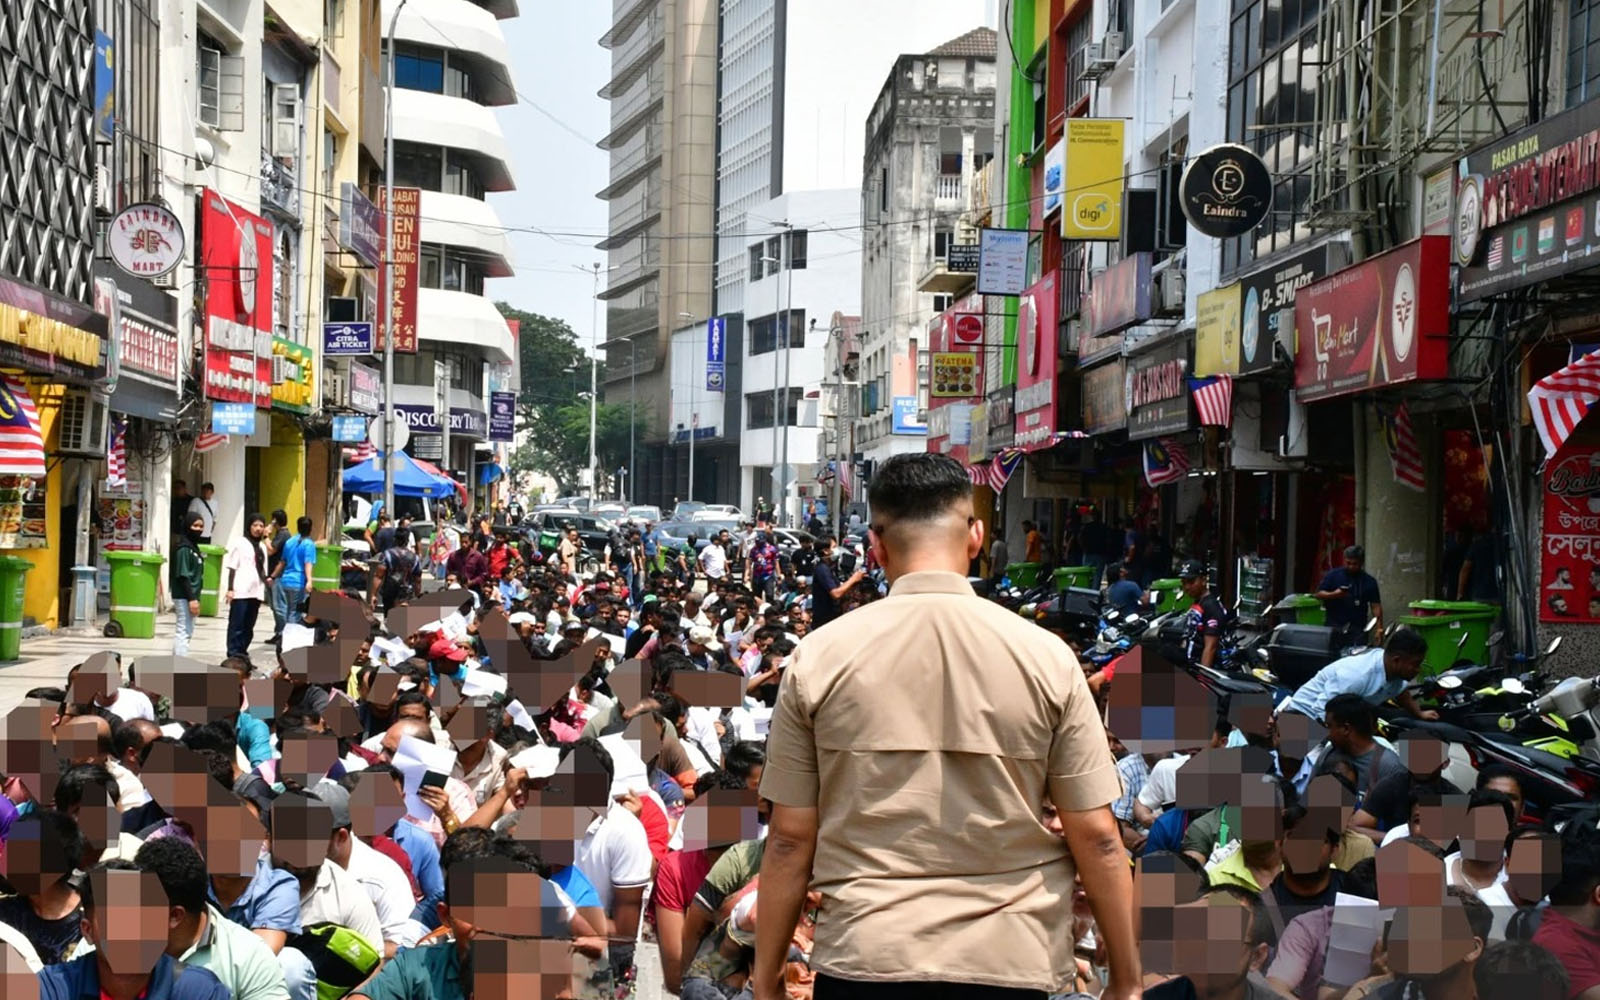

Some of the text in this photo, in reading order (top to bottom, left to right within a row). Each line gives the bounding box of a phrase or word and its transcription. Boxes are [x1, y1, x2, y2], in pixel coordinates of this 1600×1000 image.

[1491, 134, 1539, 171] PASAR RAYA
[382, 190, 418, 202] PJABAT
[1080, 208, 1100, 222] digi
[1203, 203, 1247, 217] Eaindra
[119, 208, 175, 231] EAINDRA
[132, 262, 164, 272] MART
